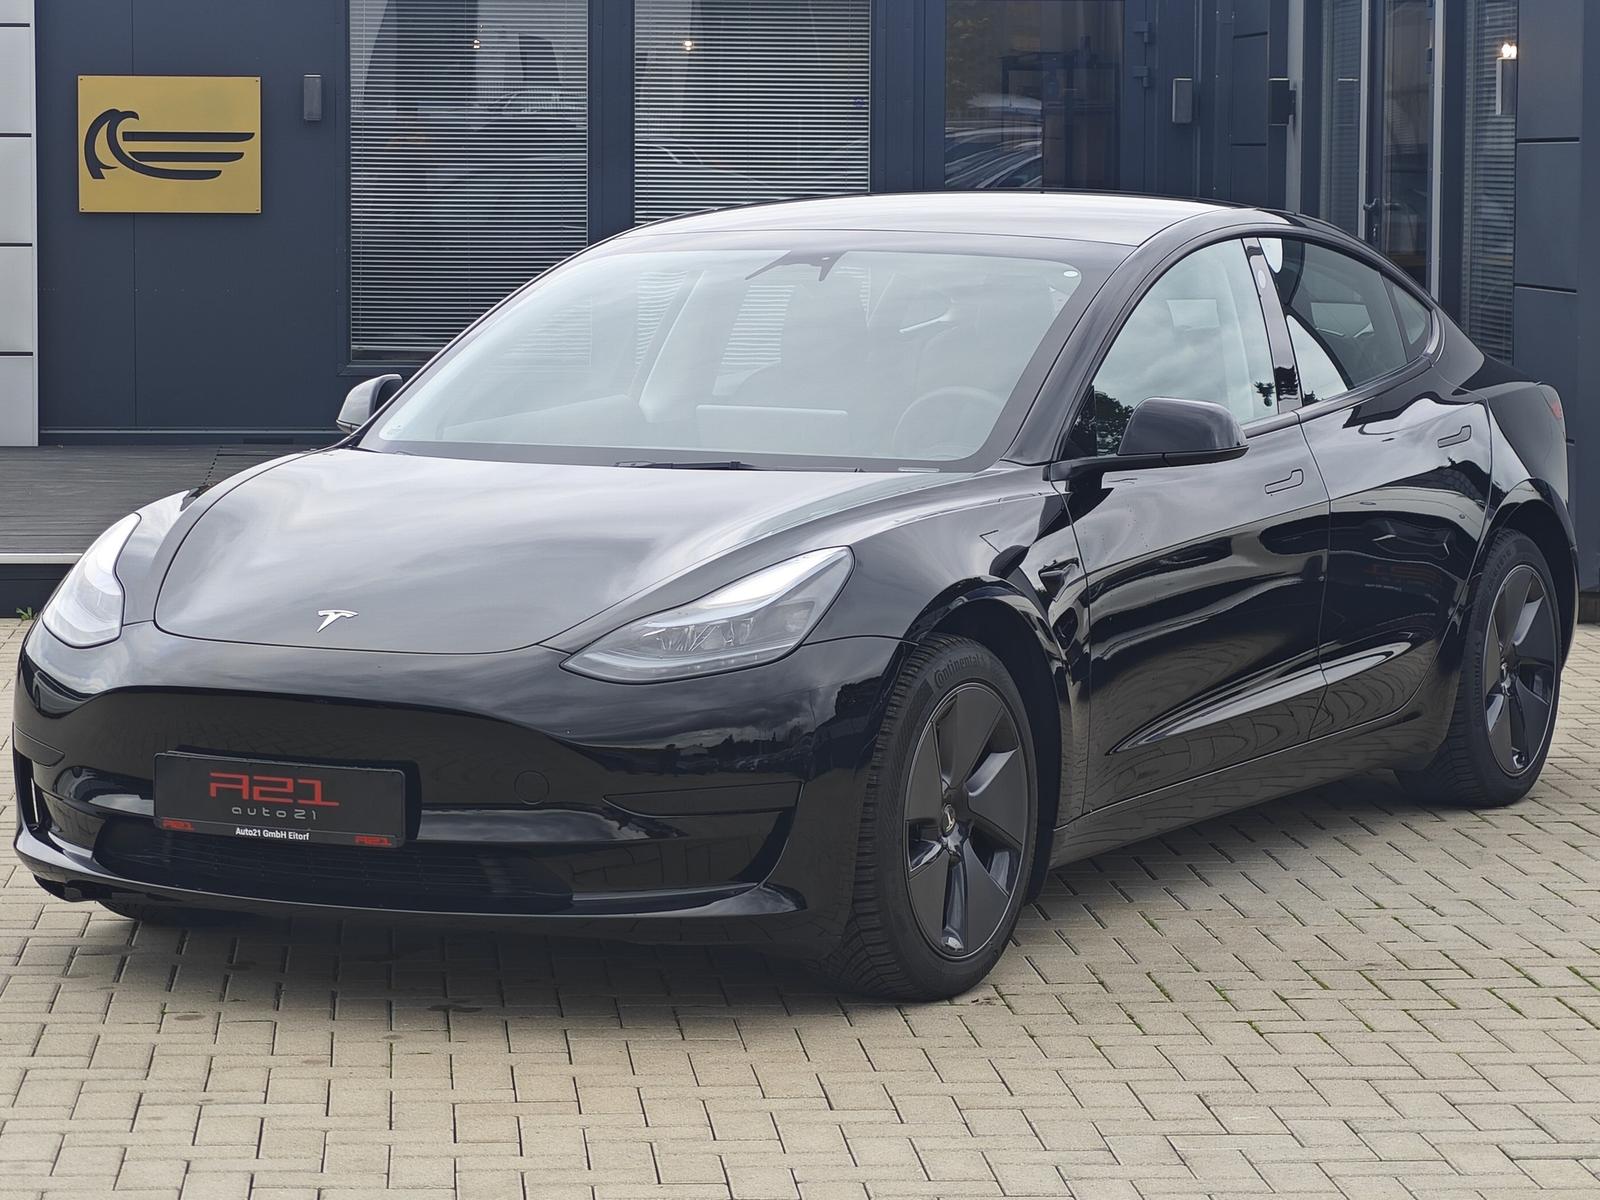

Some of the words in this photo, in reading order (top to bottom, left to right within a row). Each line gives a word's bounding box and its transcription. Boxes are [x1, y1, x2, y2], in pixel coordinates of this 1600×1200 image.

[935, 654, 981, 689] Continental
[209, 772, 340, 807] A21
[231, 806, 317, 820] auto21
[235, 827, 261, 837] Auto21
[262, 829, 287, 839] GmbH
[288, 831, 310, 840] Eitorf
